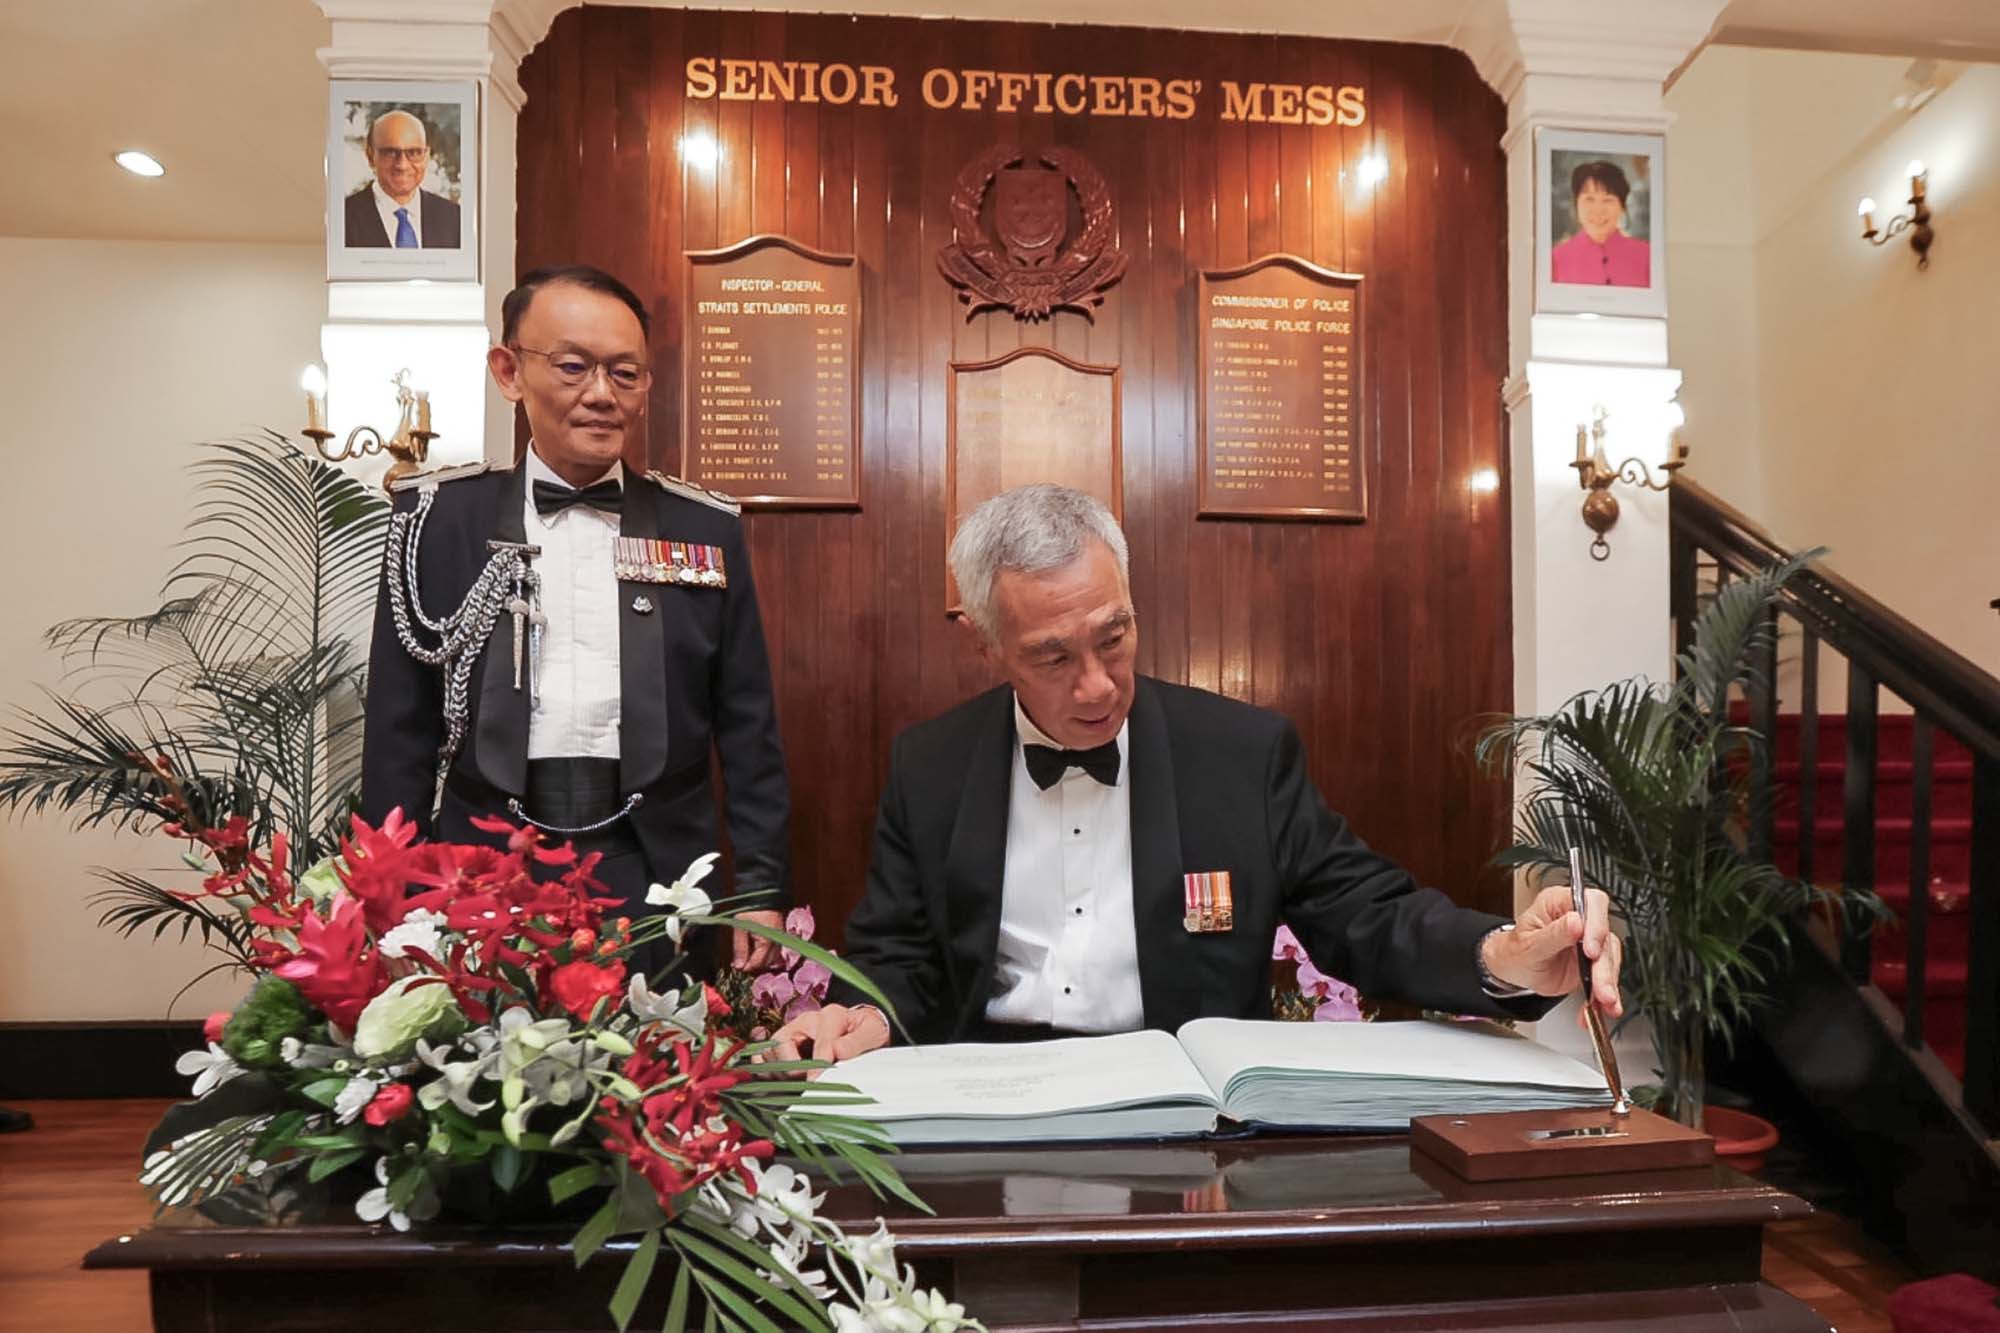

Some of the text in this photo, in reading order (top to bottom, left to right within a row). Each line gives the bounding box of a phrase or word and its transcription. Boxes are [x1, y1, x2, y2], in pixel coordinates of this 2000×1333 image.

[686, 57, 1366, 127] SENIOR OFFICERS' MESS
[698, 301, 848, 315] STRAITS SETTLEMENTS POLICE
[1212, 295, 1350, 312] COMMISSIONER OF POLICE
[1212, 317, 1351, 335] SINGAPORE POLICE FORCE
